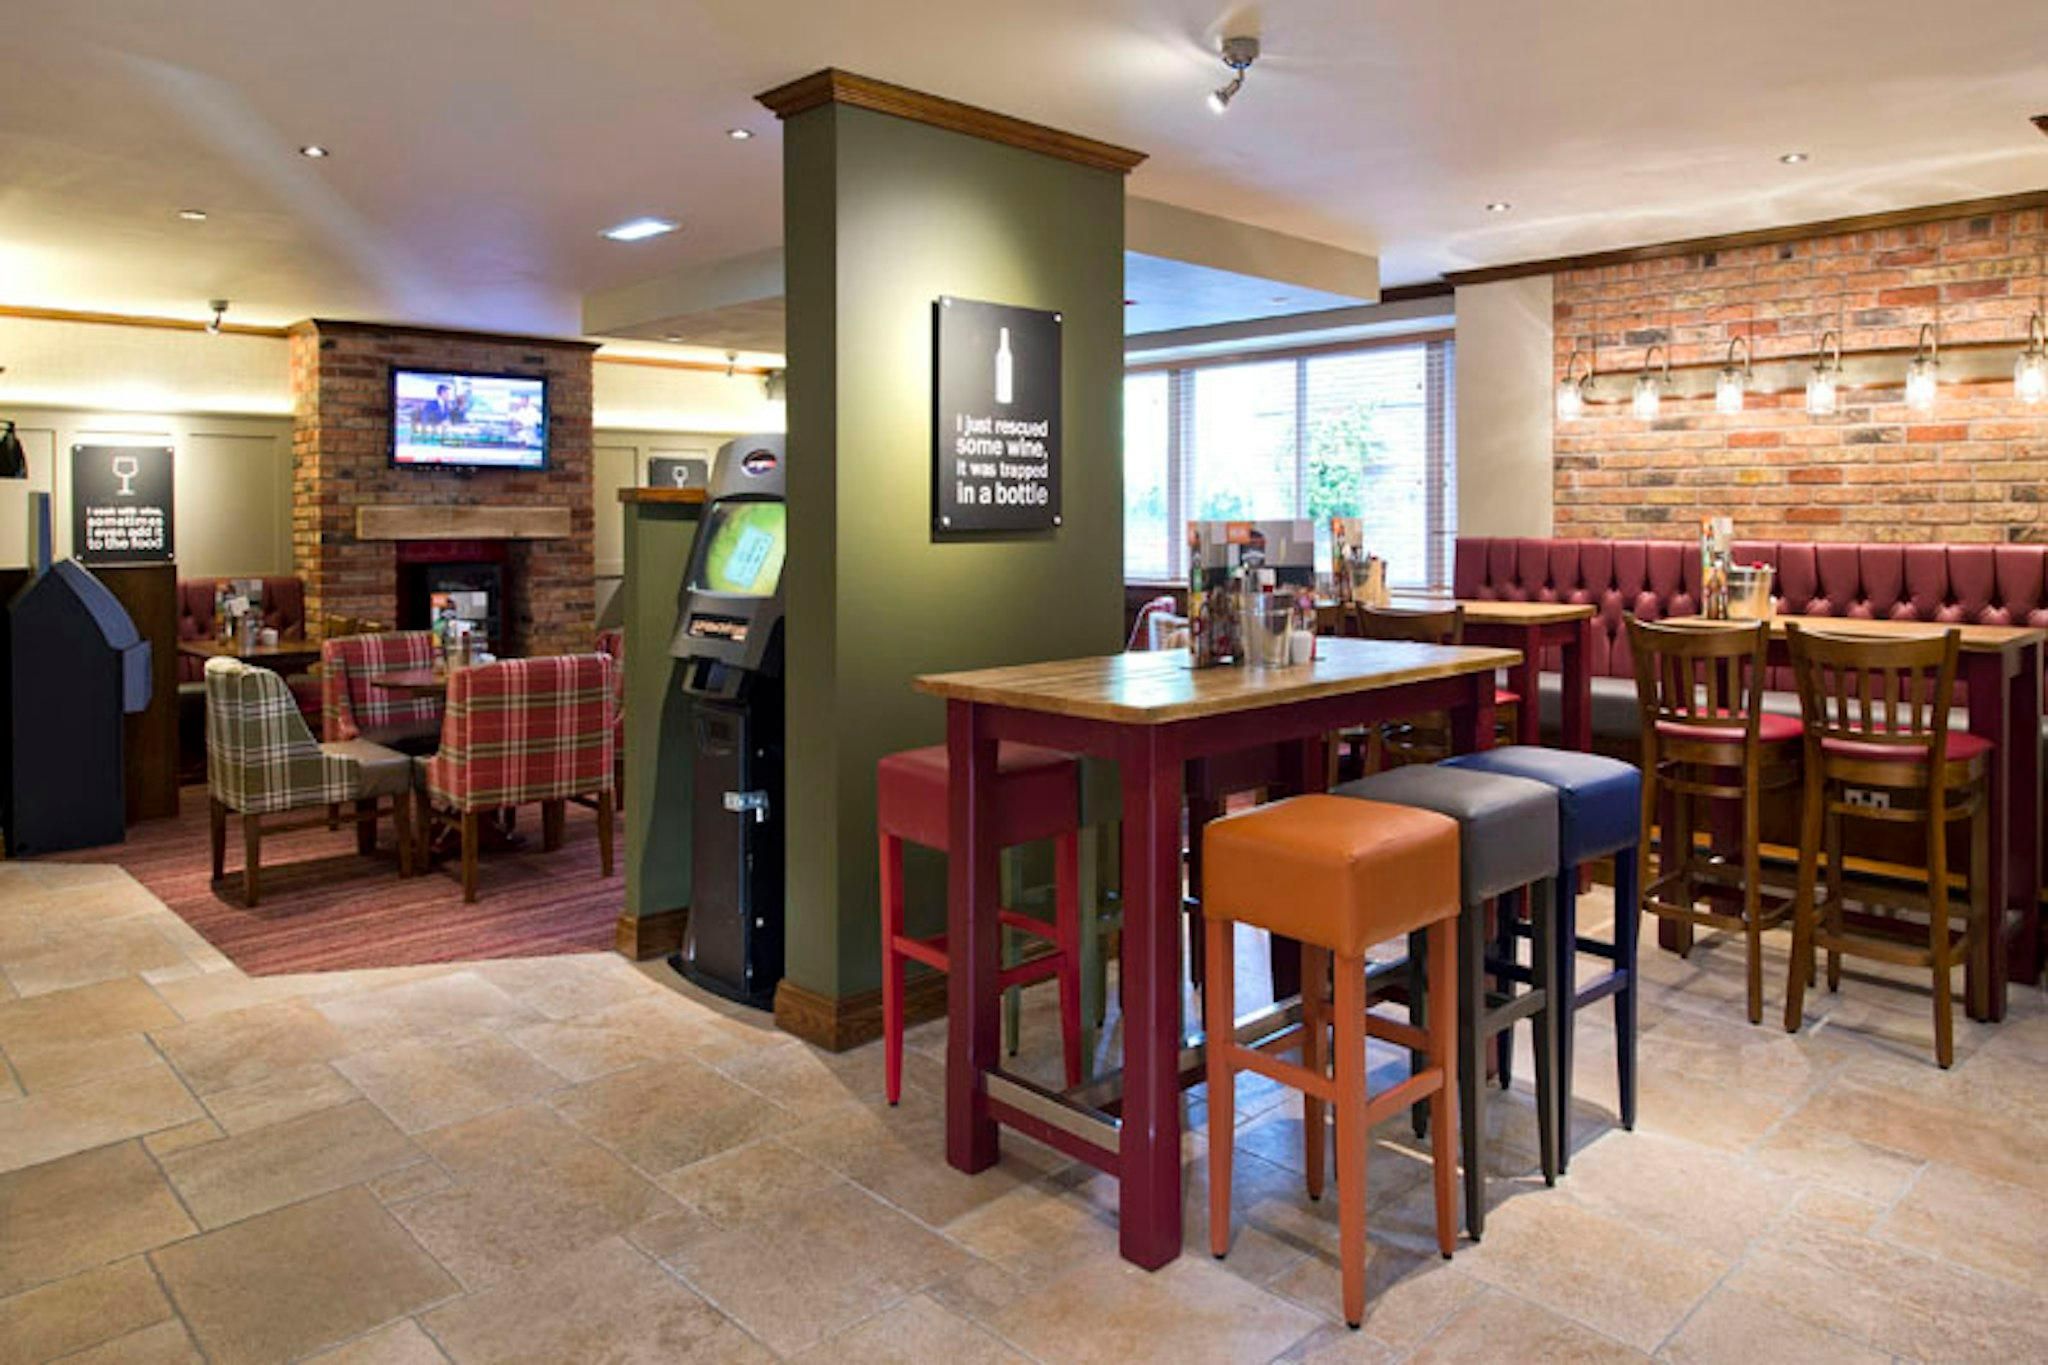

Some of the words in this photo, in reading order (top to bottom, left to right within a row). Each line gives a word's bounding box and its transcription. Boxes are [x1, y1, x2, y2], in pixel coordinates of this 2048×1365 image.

[964, 415, 992, 436] just
[995, 419, 1048, 437] rescued
[956, 437, 1003, 455] some
[1006, 437, 1048, 460] wine,
[969, 463, 996, 478] was
[1000, 461, 1048, 480] trapped
[979, 485, 992, 504] a
[995, 481, 1048, 505] bottle
[87, 516, 163, 526] sometimes
[104, 537, 129, 550] the
